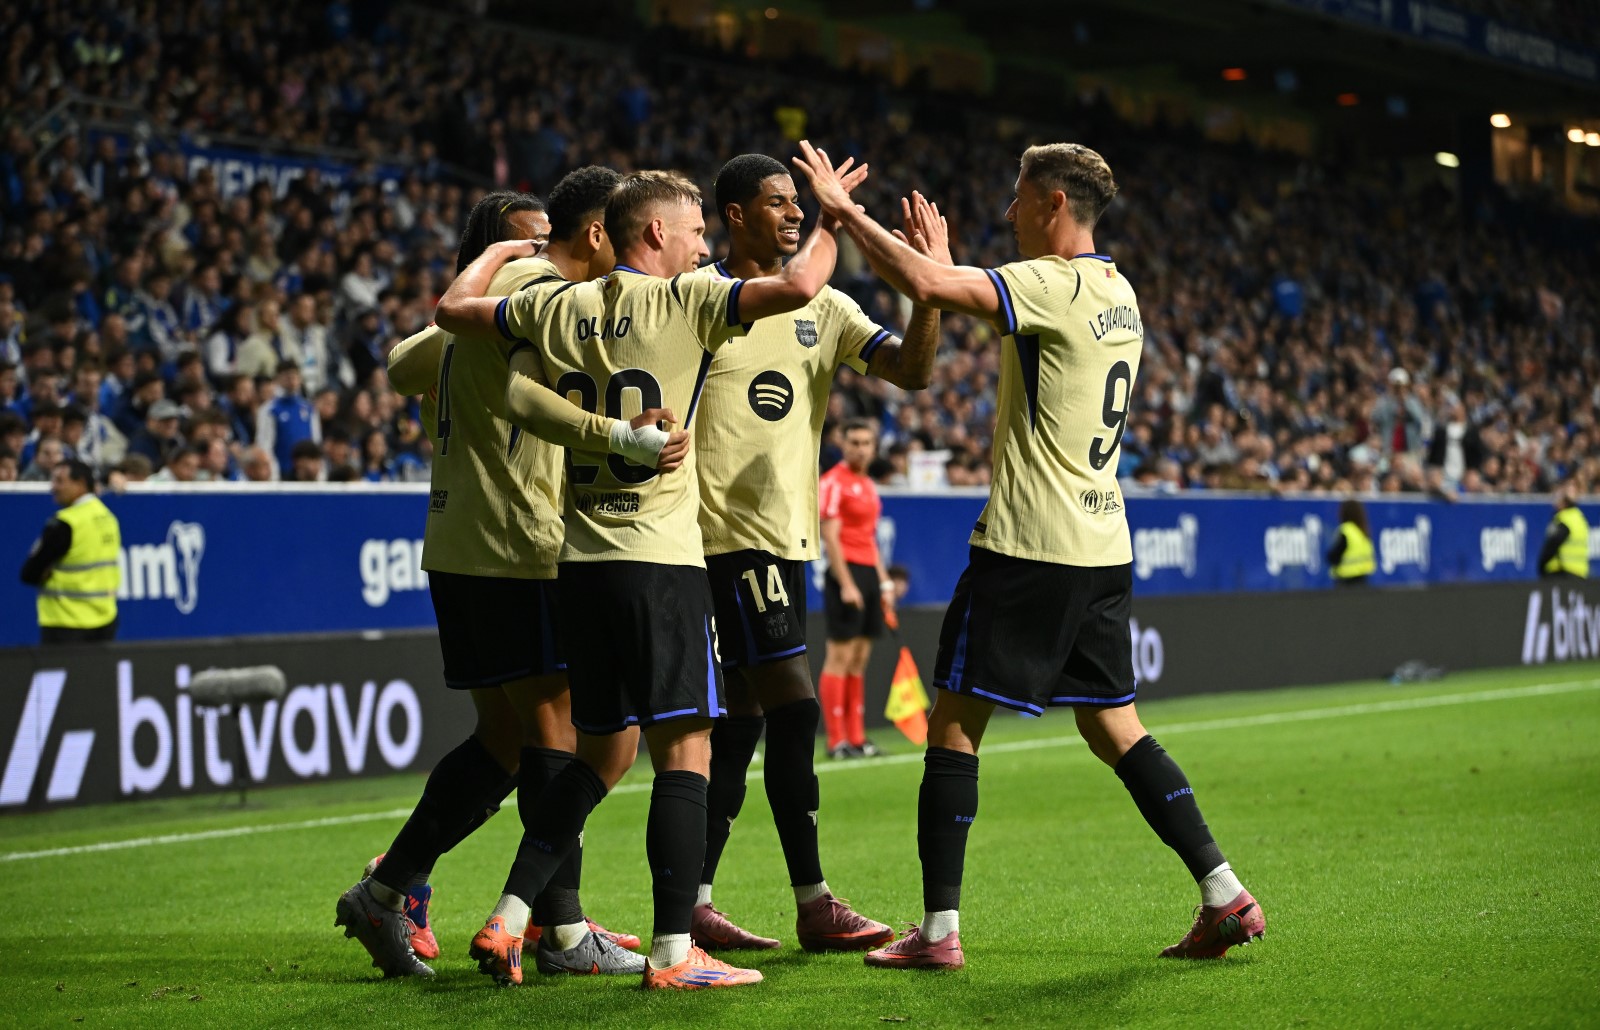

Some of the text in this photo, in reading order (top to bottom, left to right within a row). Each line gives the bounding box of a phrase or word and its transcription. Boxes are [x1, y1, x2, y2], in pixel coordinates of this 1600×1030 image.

[1089, 305, 1143, 342] LEWANDOWS
[1089, 360, 1130, 471] 9
[597, 502, 639, 513] ACNUR
[600, 492, 639, 503] UNHCR
[741, 564, 790, 613] 14
[117, 660, 422, 794] bitvavo
